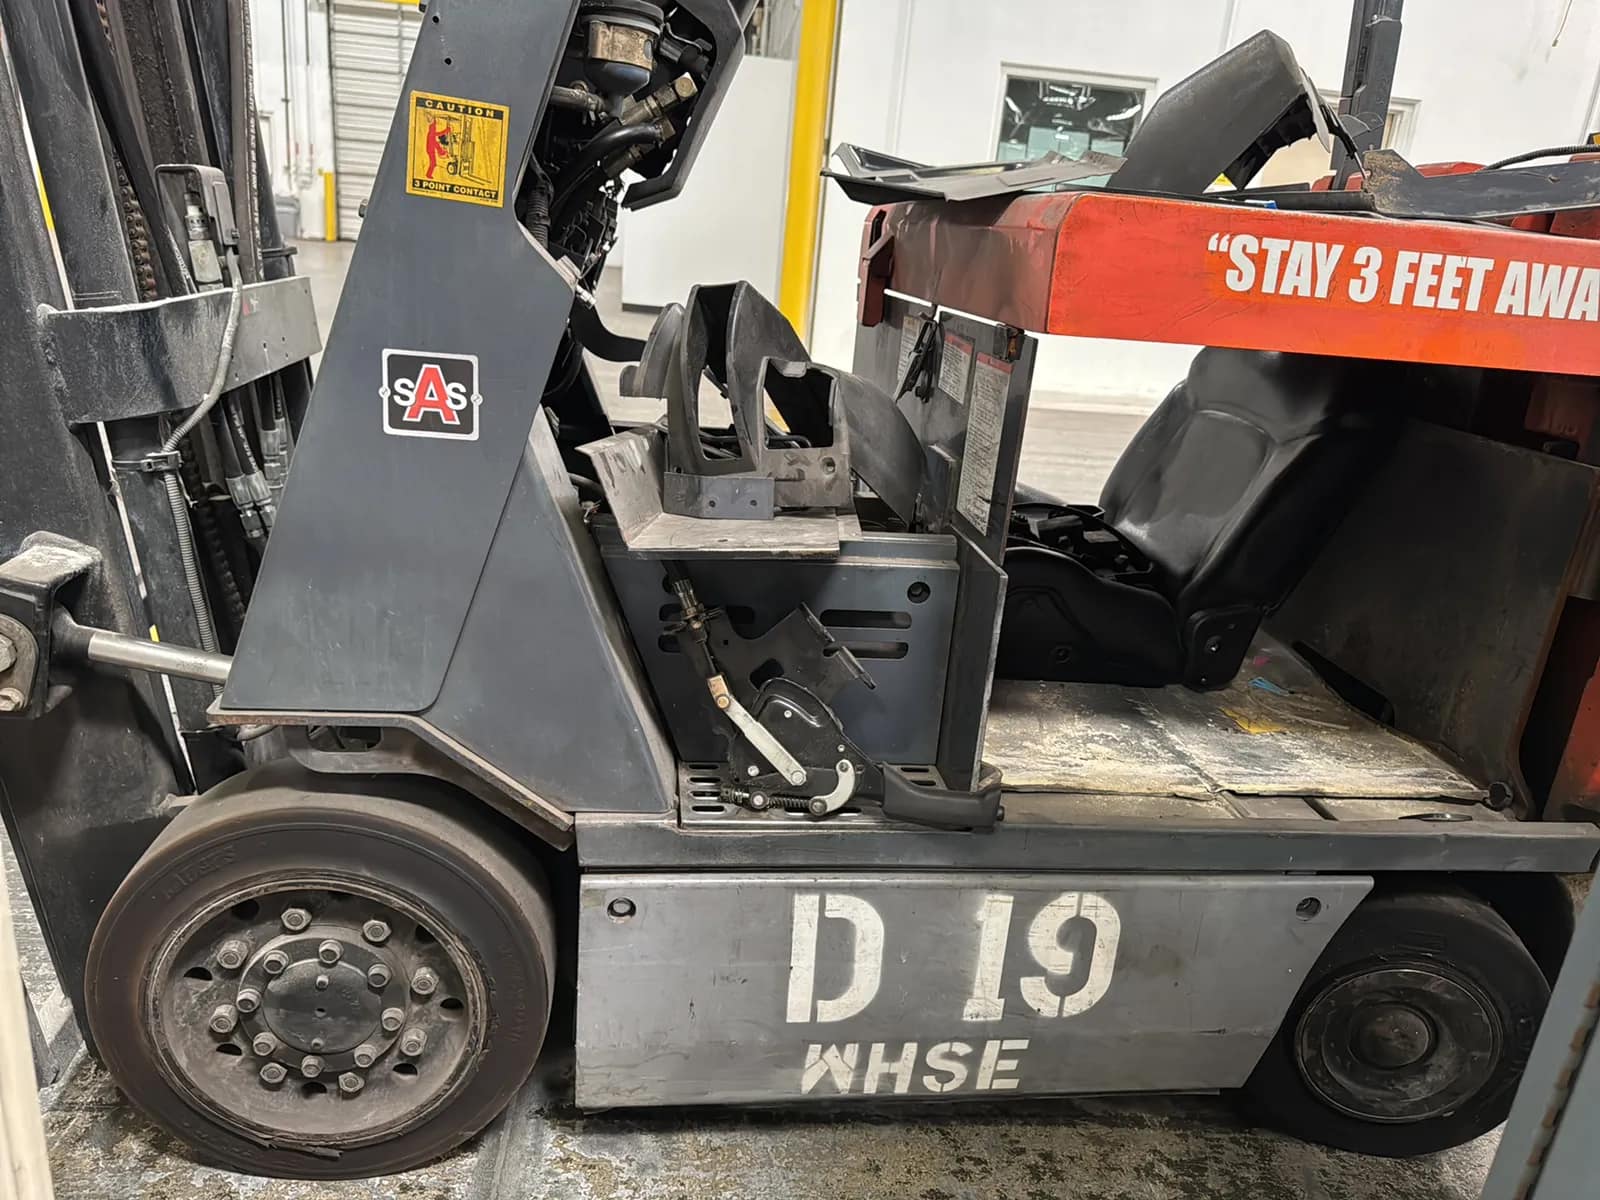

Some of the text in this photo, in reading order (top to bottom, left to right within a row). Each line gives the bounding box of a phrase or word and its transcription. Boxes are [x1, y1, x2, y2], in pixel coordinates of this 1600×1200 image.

[425, 100, 494, 117] CAUTION
[422, 181, 451, 193] POINT
[453, 184, 497, 199] CONTACT
[1348, 246, 1383, 303] 3
[1389, 250, 1495, 312] FEET
[393, 363, 468, 425] SAS
[786, 892, 1121, 1023] D 19
[801, 1039, 1030, 1095] WHSE
